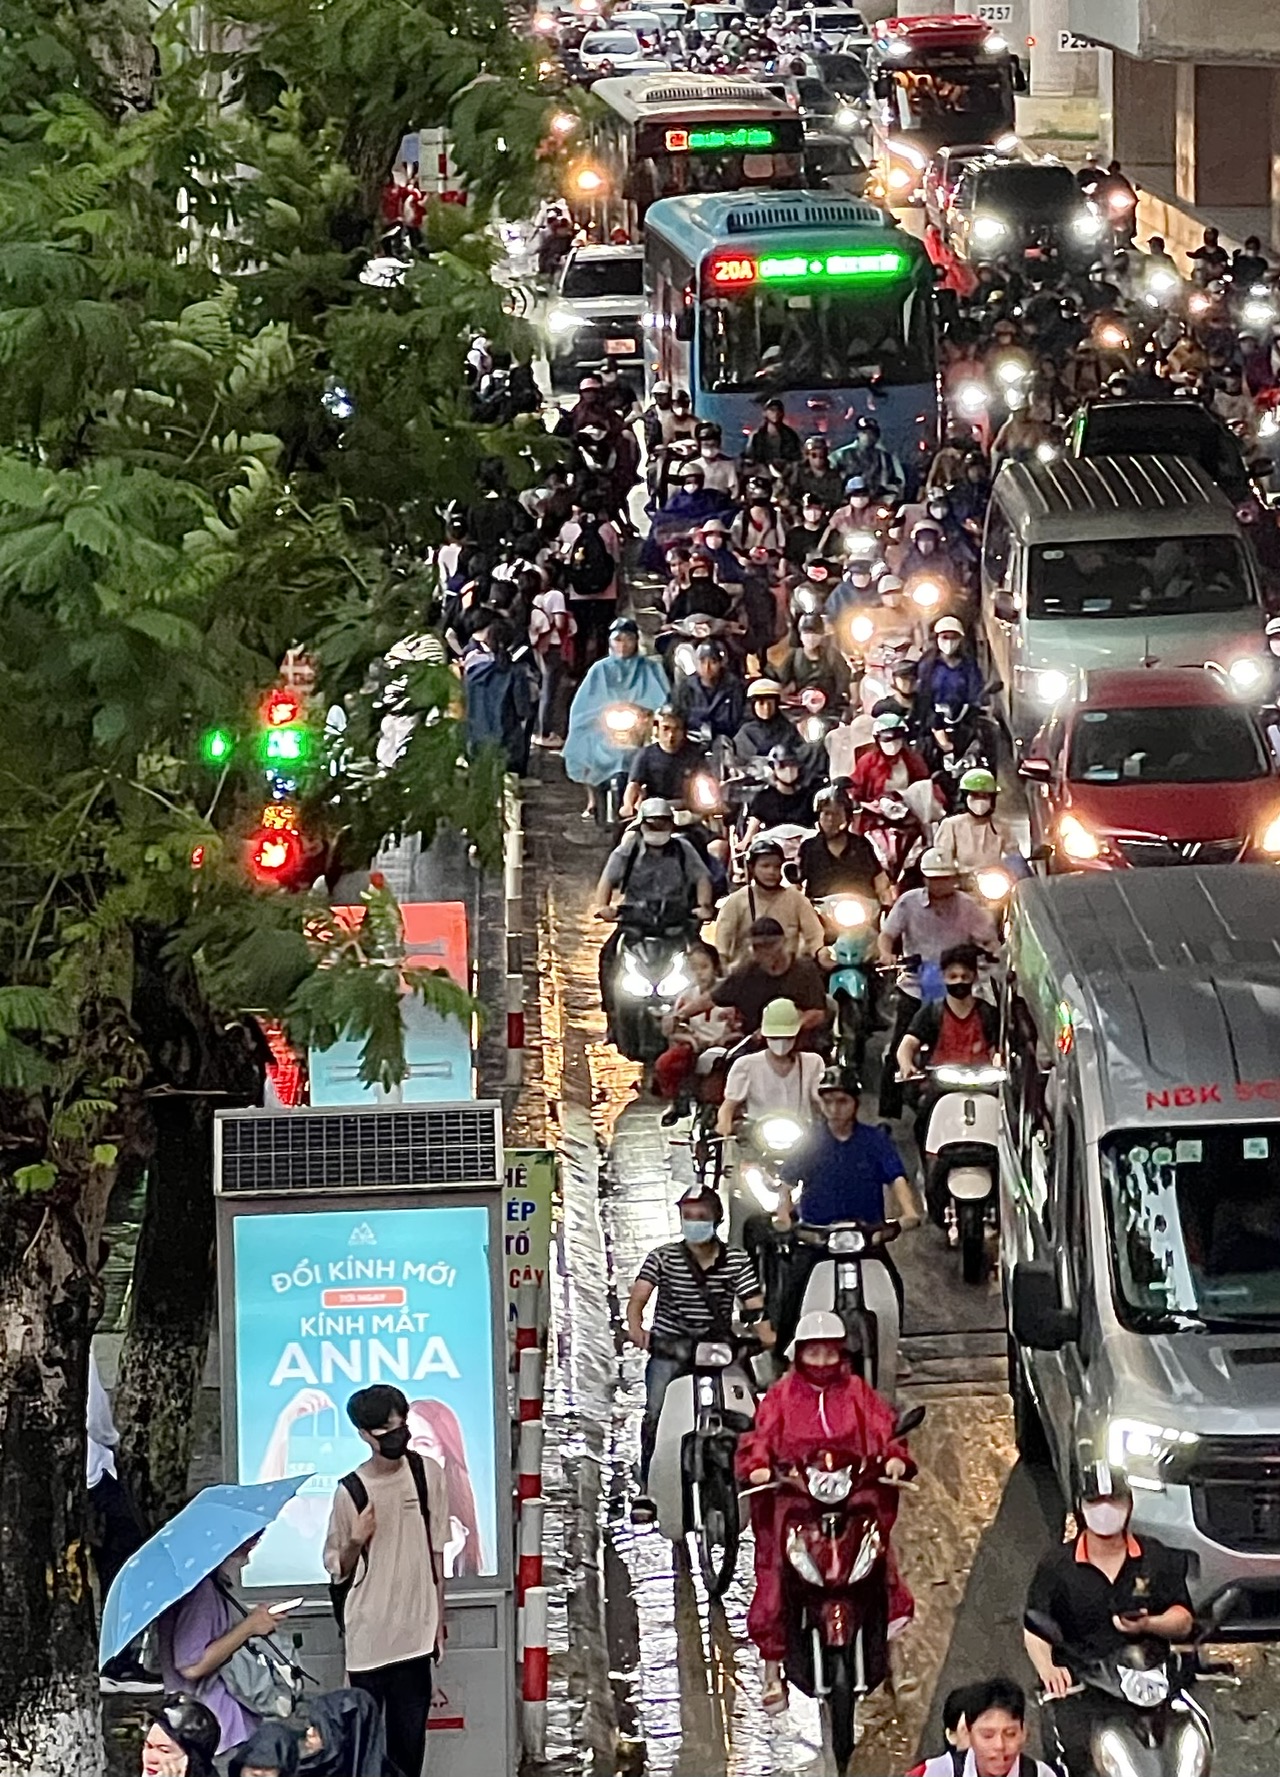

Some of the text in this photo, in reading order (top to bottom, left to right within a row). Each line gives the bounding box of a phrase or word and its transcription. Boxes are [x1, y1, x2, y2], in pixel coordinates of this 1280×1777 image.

[980, 7, 1010, 20] P257
[1061, 33, 1096, 49] P2
[715, 260, 753, 281] 20A
[1146, 1083, 1221, 1111] NBK
[328, 1254, 396, 1281] KÍNH
[401, 1260, 457, 1288] MỚI
[300, 1306, 430, 1338] KÍNH MẮT
[269, 1336, 462, 1386] ANNA
